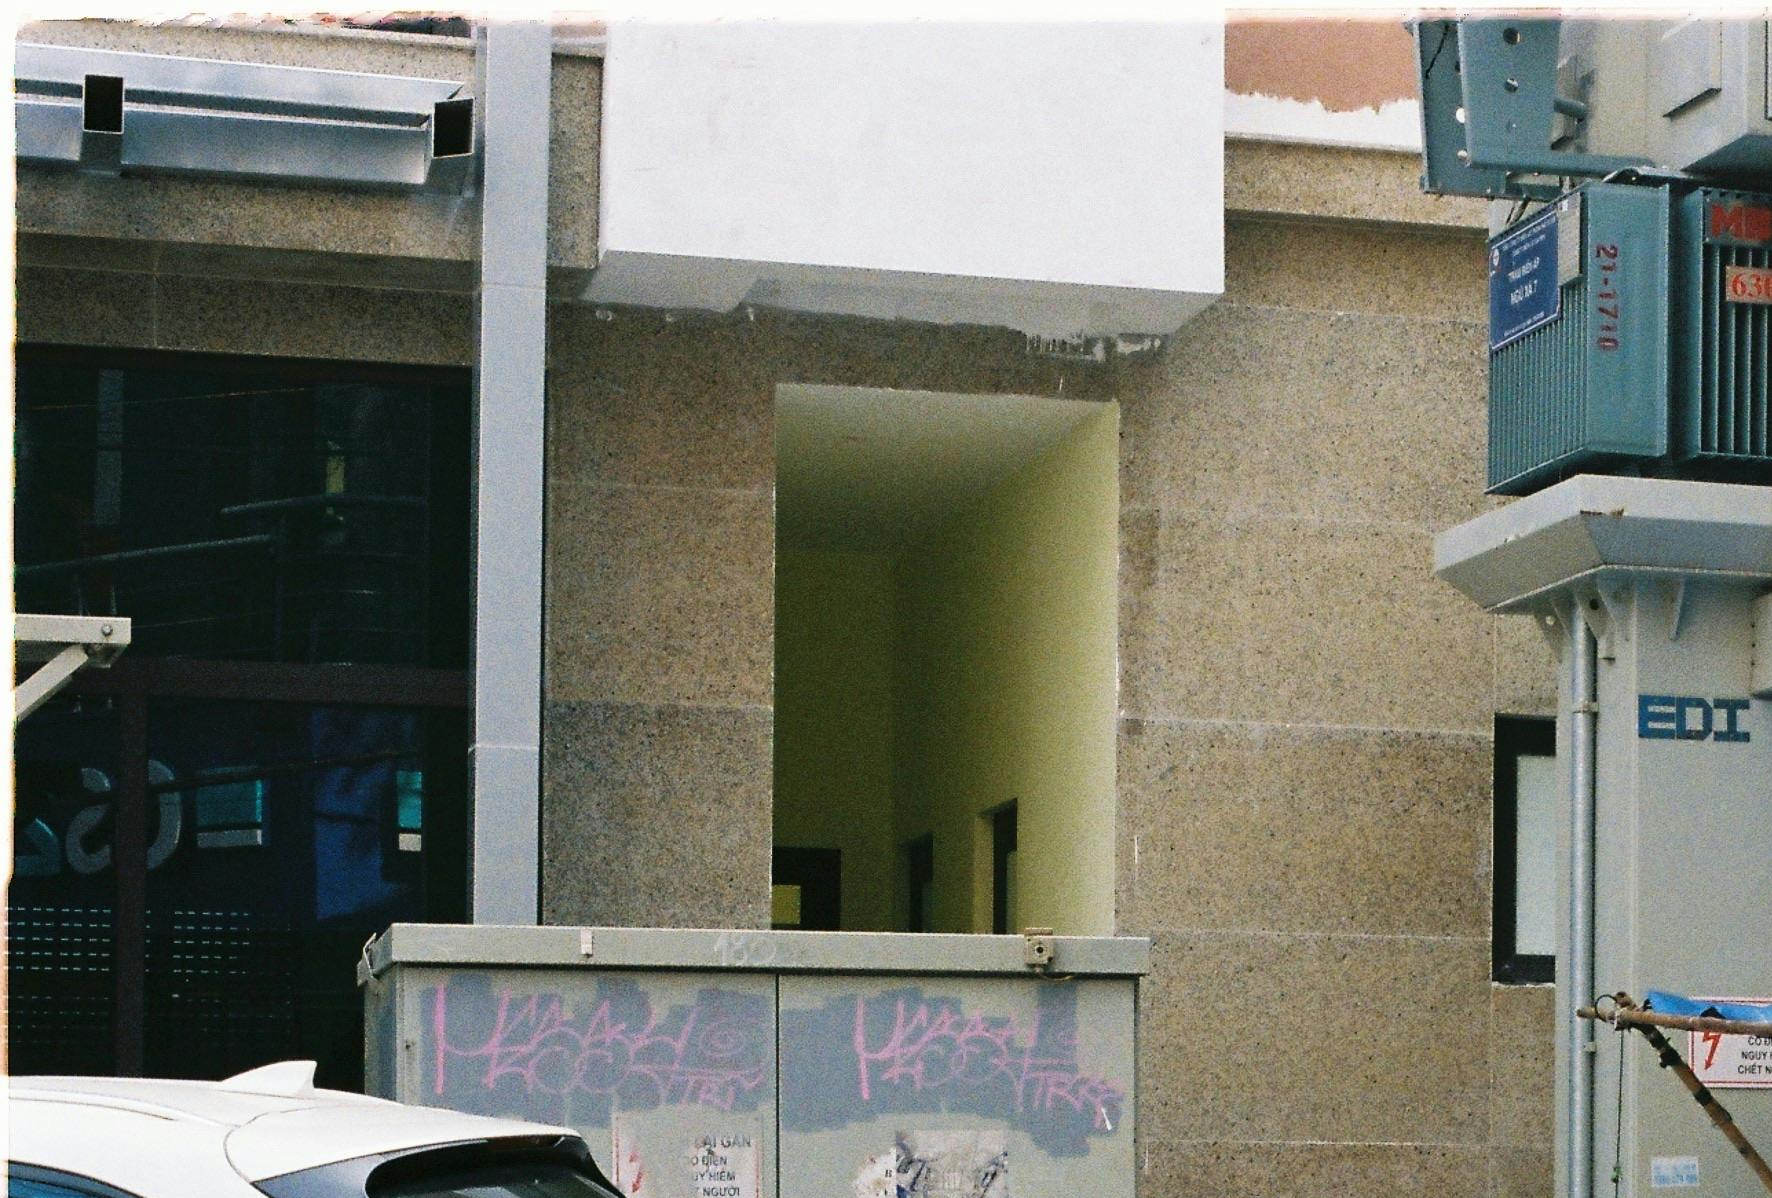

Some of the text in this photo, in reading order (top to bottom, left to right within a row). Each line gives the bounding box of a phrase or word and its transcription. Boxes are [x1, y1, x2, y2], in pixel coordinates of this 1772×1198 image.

[1638, 694, 1750, 743] EDI
[1741, 1051, 1767, 1060] NGUY
[702, 1186, 740, 1198] NGƯỜI
